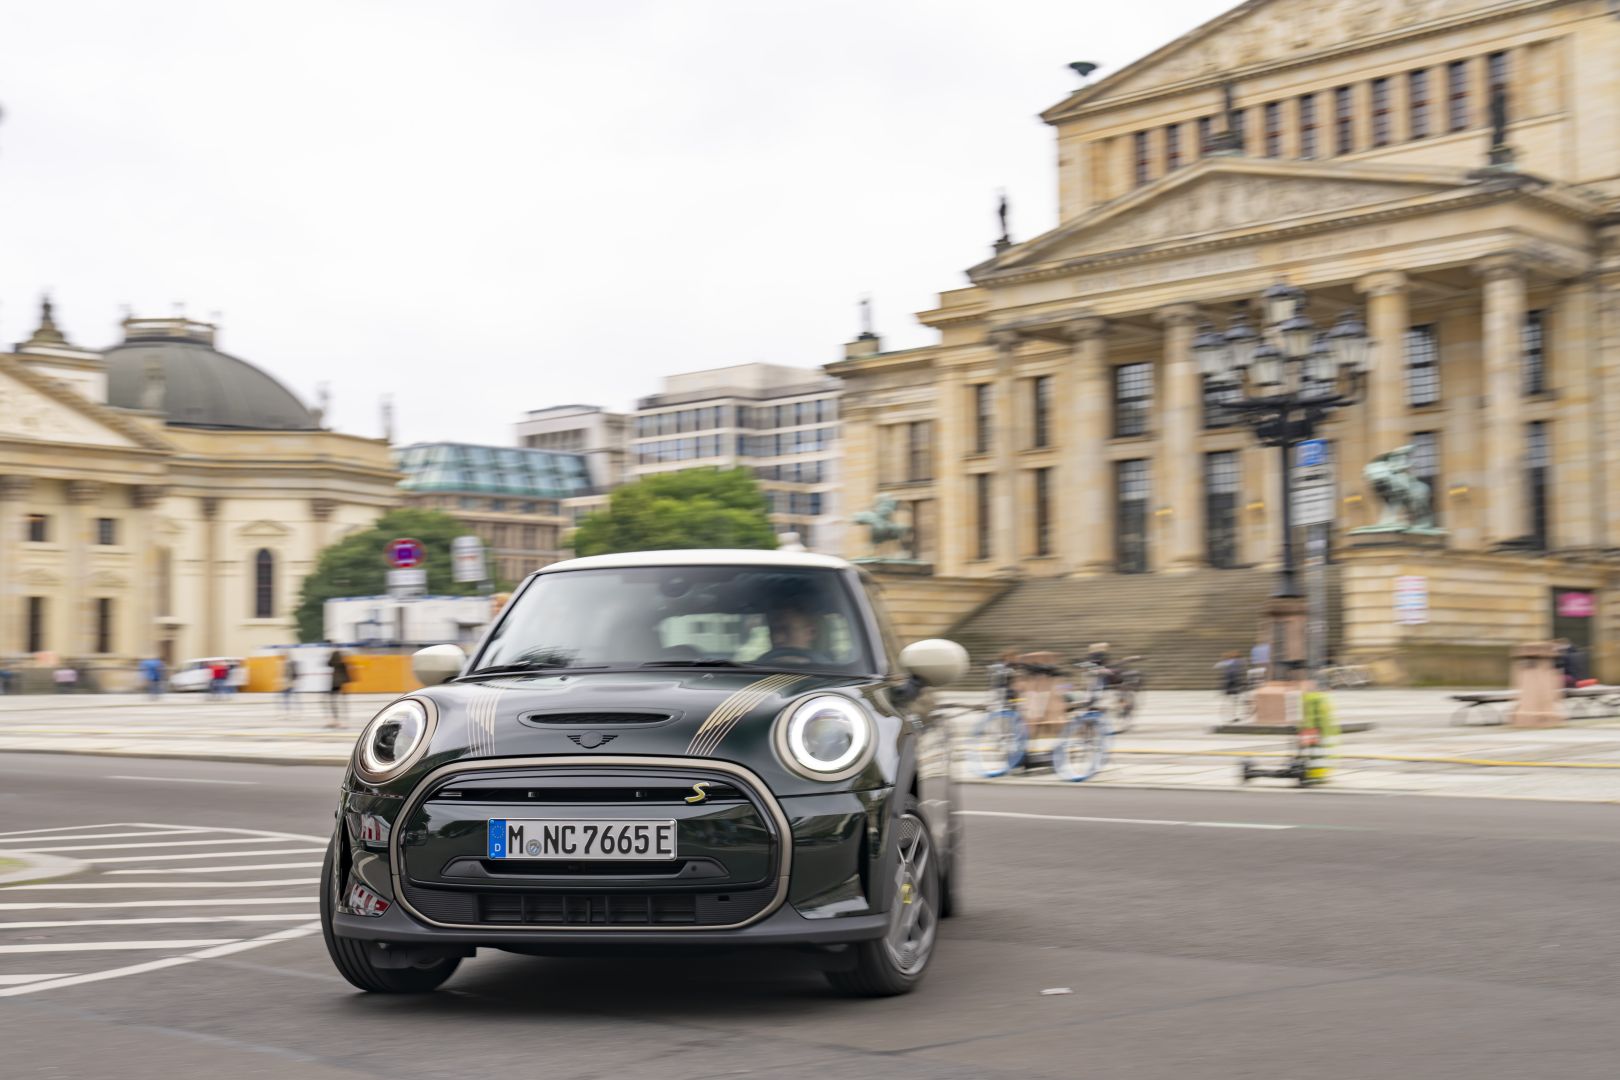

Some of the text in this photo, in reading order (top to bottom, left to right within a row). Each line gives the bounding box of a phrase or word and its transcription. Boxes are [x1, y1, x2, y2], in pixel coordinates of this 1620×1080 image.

[685, 782, 710, 803] S
[494, 843, 501, 852] D
[508, 825, 524, 854] M
[543, 825, 576, 854] NC
